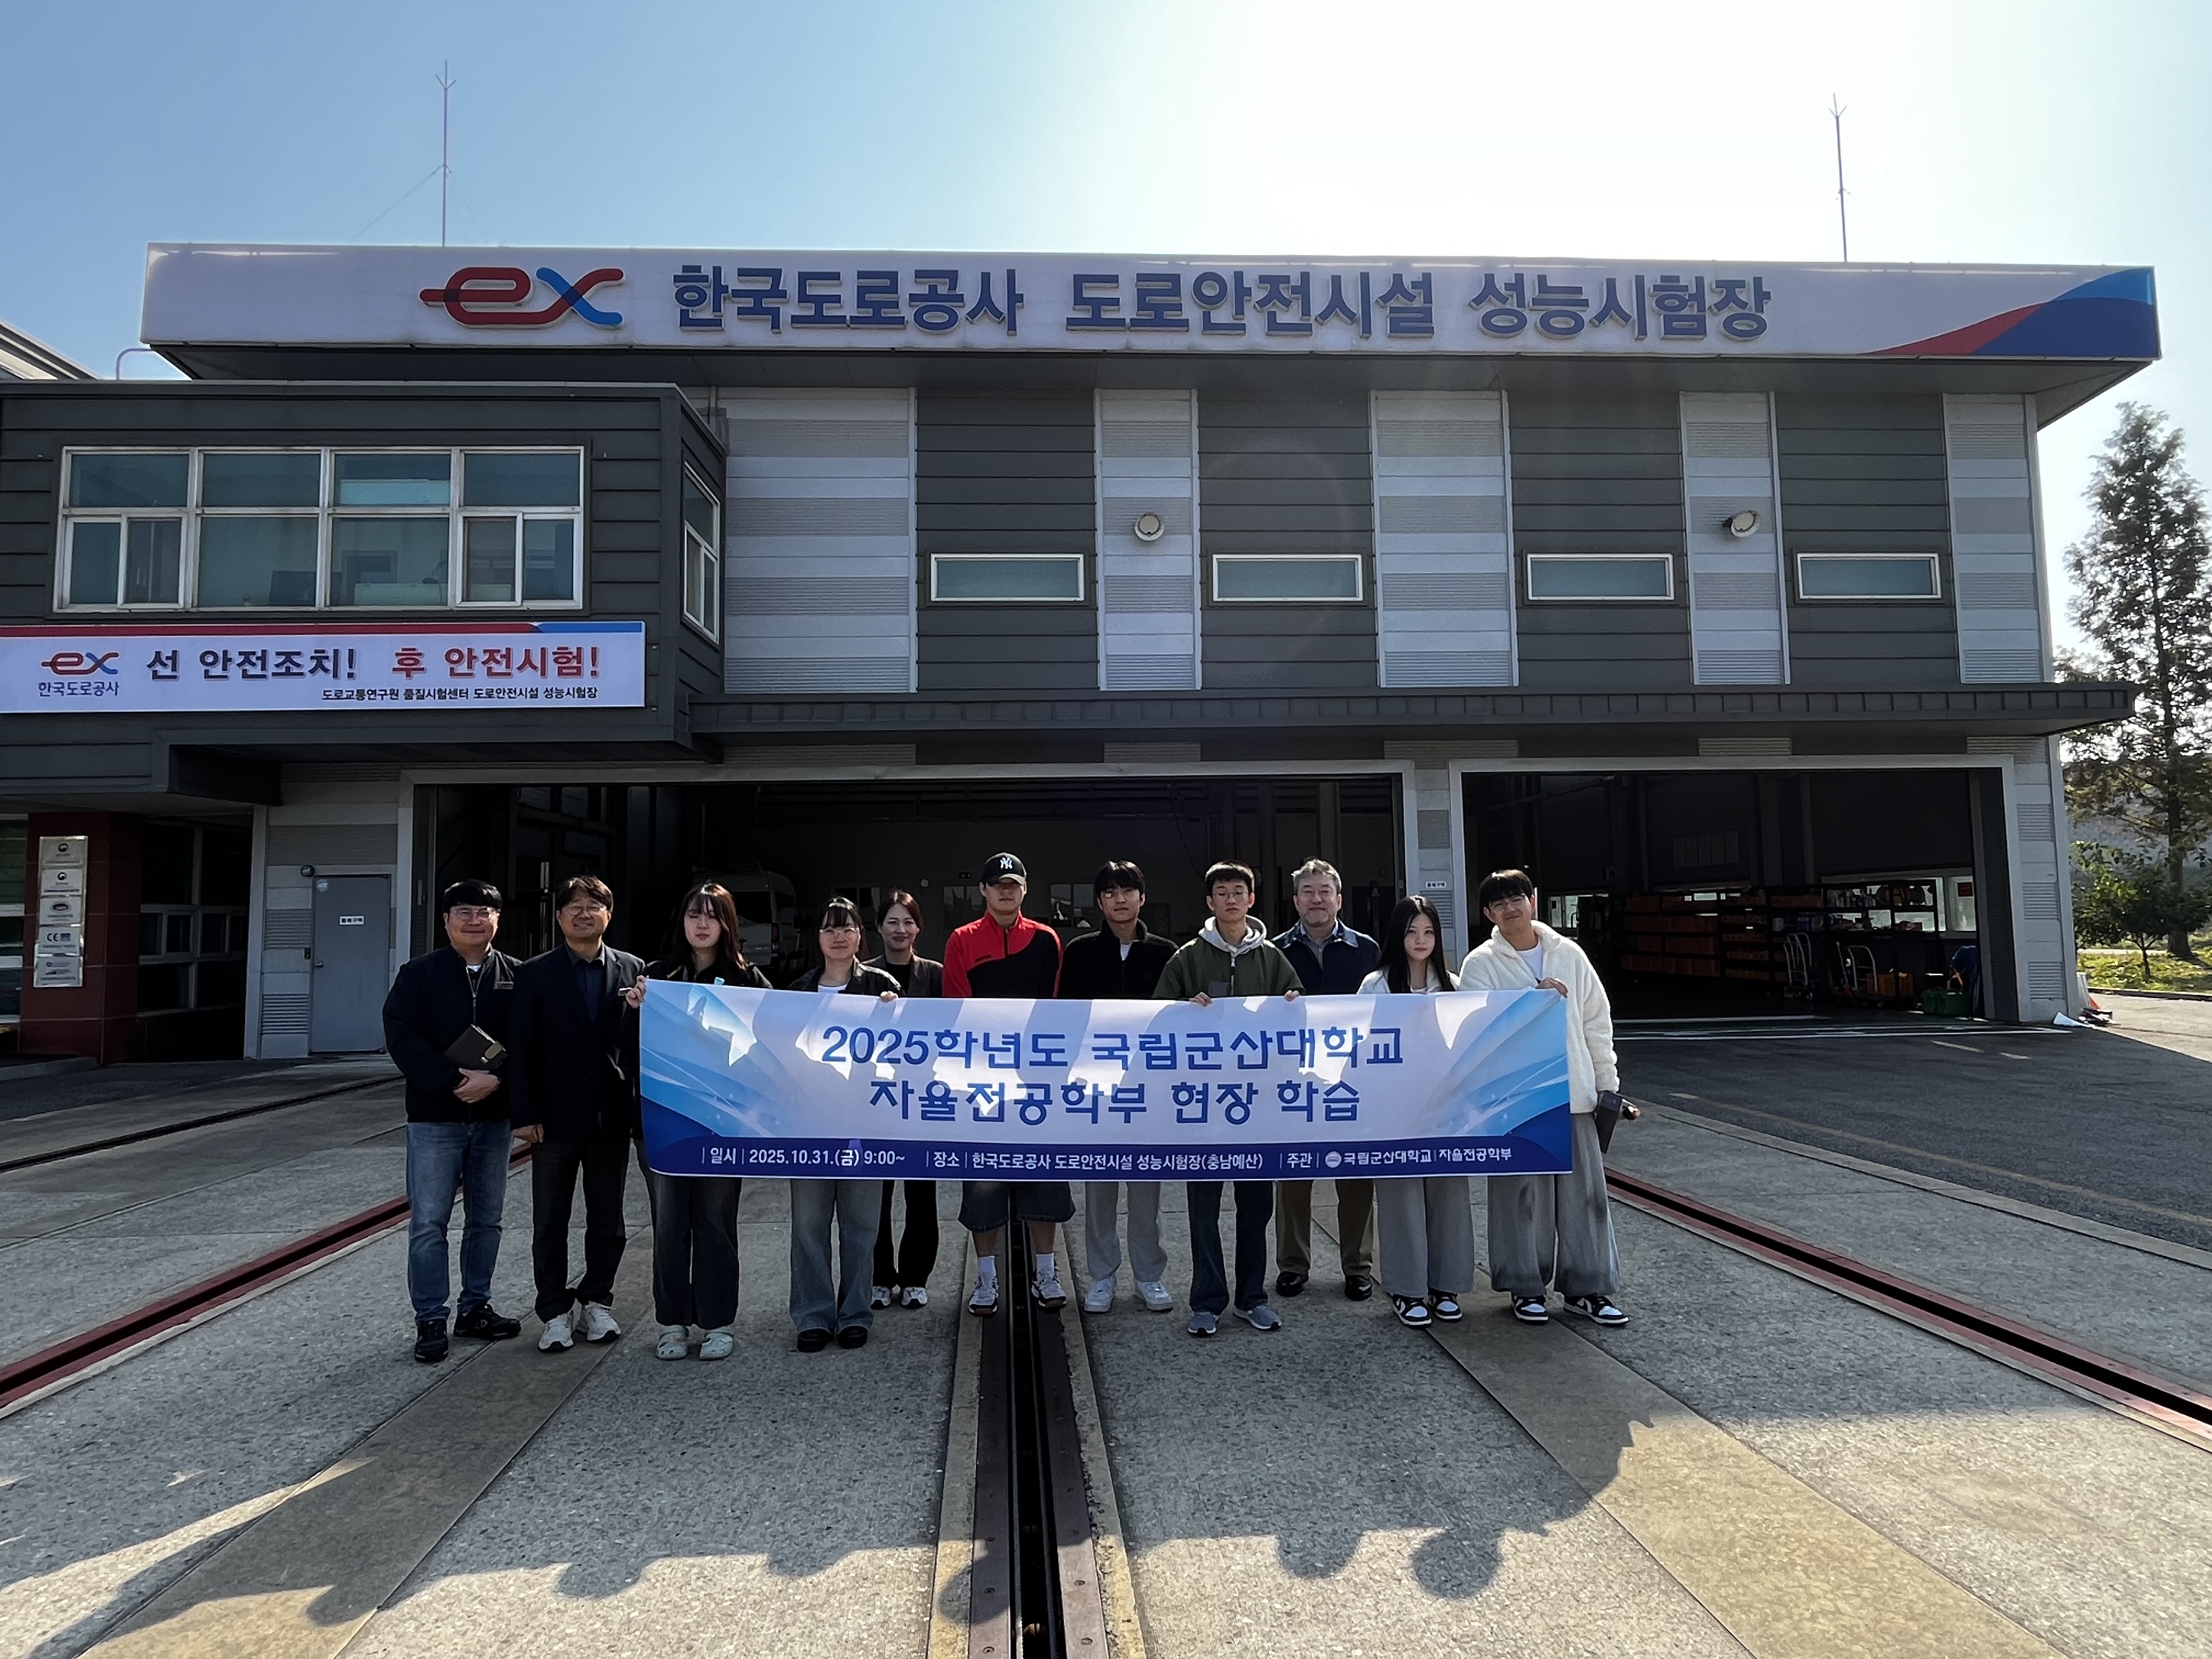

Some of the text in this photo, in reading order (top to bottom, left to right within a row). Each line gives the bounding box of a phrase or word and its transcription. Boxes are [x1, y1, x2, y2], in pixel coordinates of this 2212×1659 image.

[420, 267, 624, 328] ex
[673, 264, 1772, 342] 한국도로공사 도로안전시설 성능시험장
[146, 645, 600, 680] 선 안전조치! 후 안전시험!
[37, 681, 120, 697] 한국도로공사
[321, 686, 599, 701] 도로교통연구원 품질시험센터 도로안전시설 성능시험장
[821, 1025, 1403, 1070] 2025학년도 국립군산대학교
[869, 1080, 1361, 1126] 자율전공학부 현장 학습
[710, 1148, 1513, 1171] 일시 2025.10.31.(금) 9:00~ 장소 한국도로공사 도로안전시설 성능시험장(충남예산) 주관 국립군산대학교 자율전공학부
